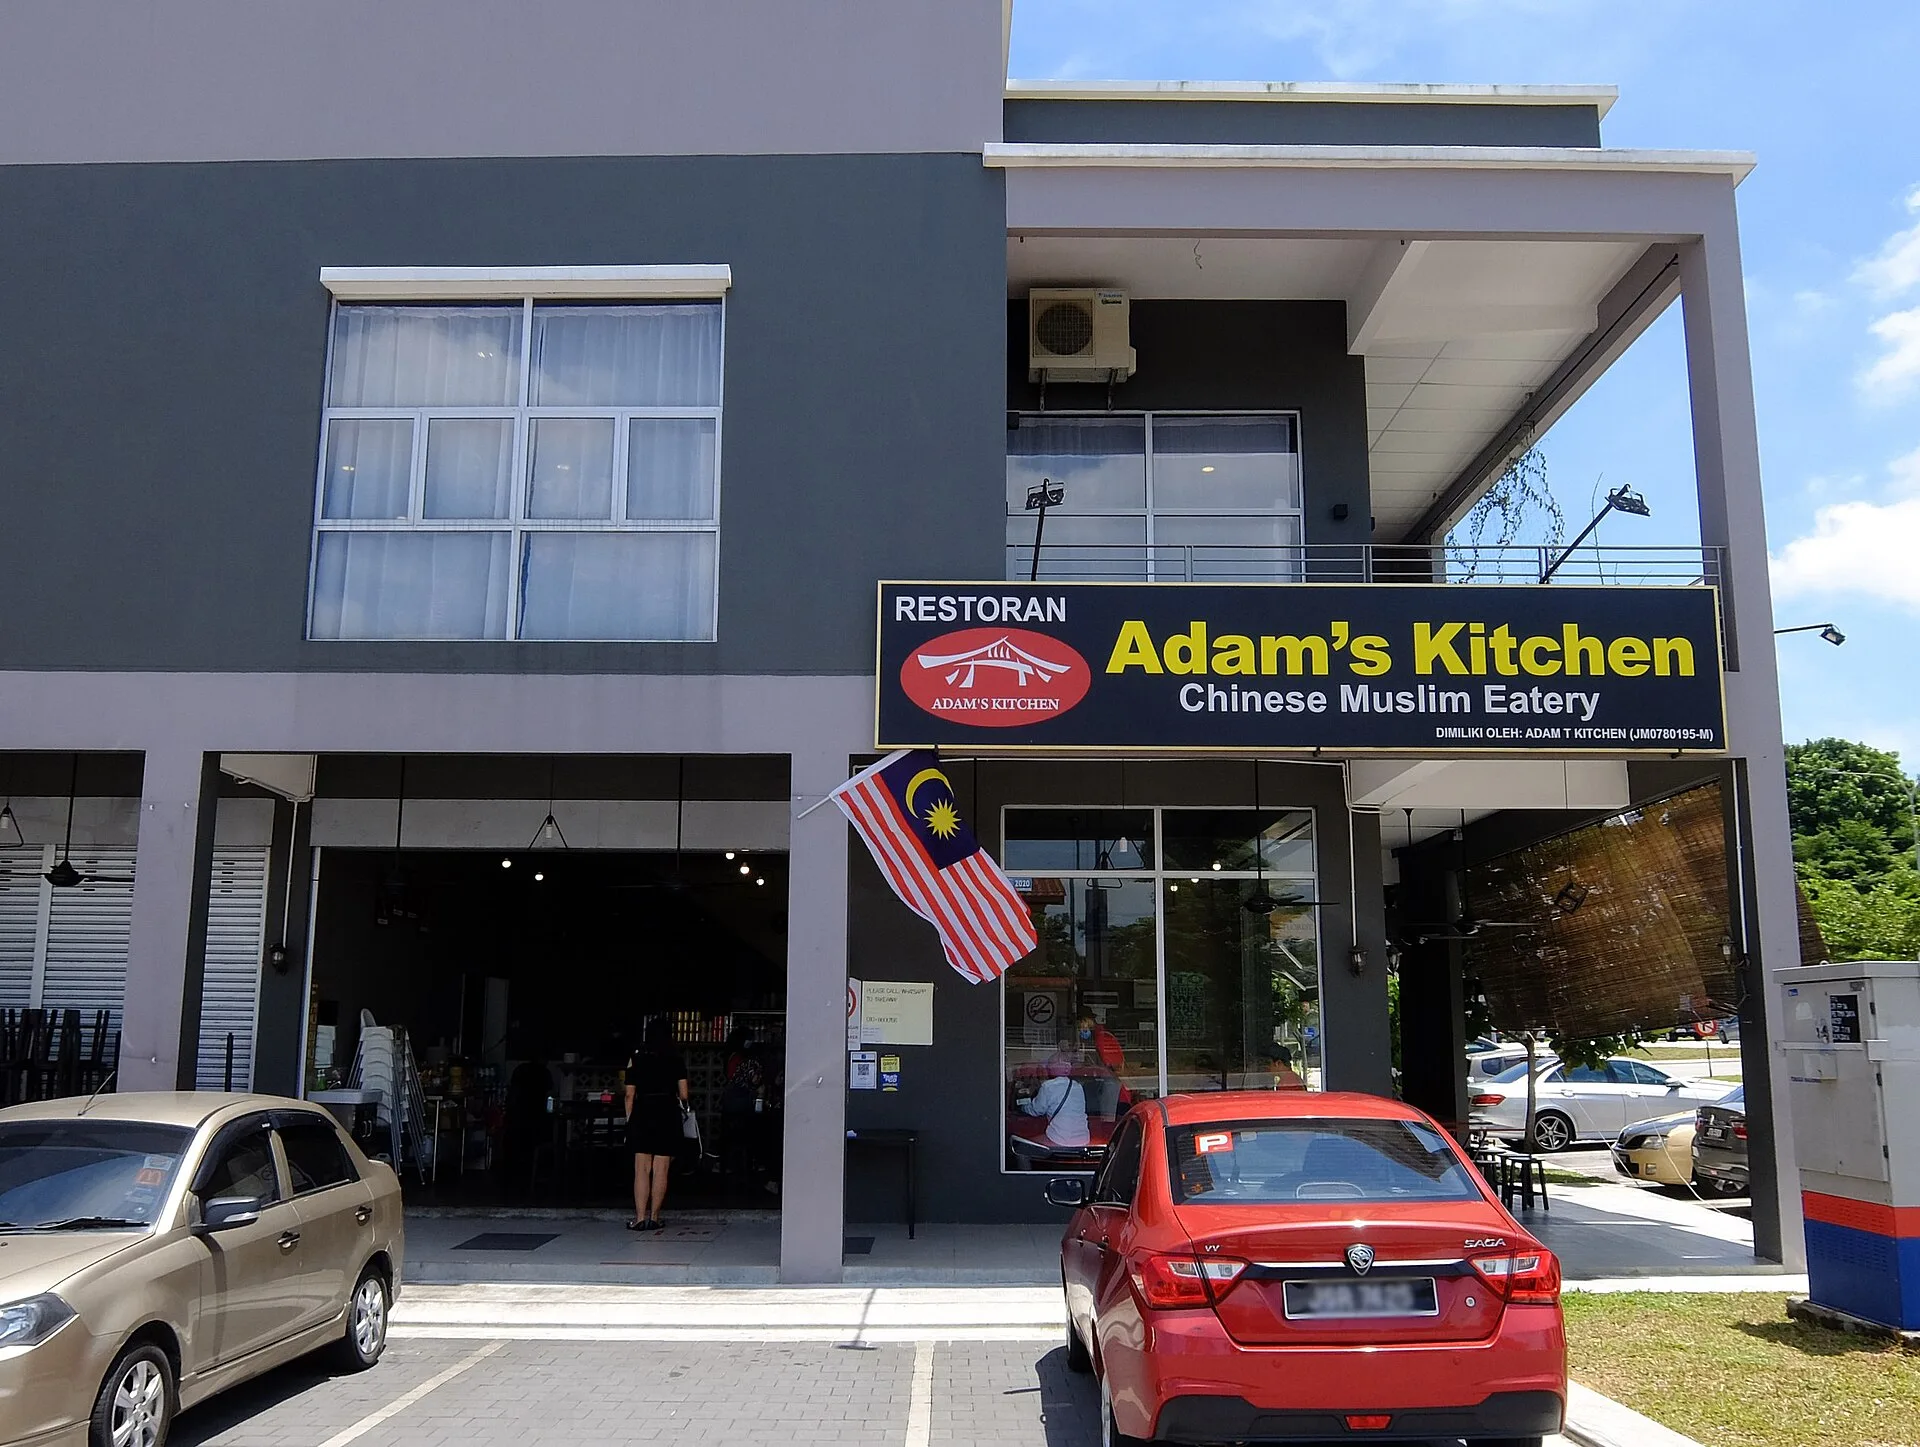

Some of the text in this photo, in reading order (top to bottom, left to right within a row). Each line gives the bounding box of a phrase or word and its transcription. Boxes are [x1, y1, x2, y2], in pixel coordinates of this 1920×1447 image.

[896, 596, 1066, 622] RESTORAN
[1105, 620, 1695, 677] Adam's Kitchen
[931, 697, 1060, 711] ADAM'S KITCHEN
[1179, 682, 1600, 721] Chinese Muslim Eatery
[1435, 727, 1714, 741] DIMILIKI OLEH: ADAM T KITCHEN (JM0780195-M)
[1014, 879, 1030, 888] 2020
[1199, 1134, 1228, 1153] P
[1463, 1238, 1507, 1249] SAGA
